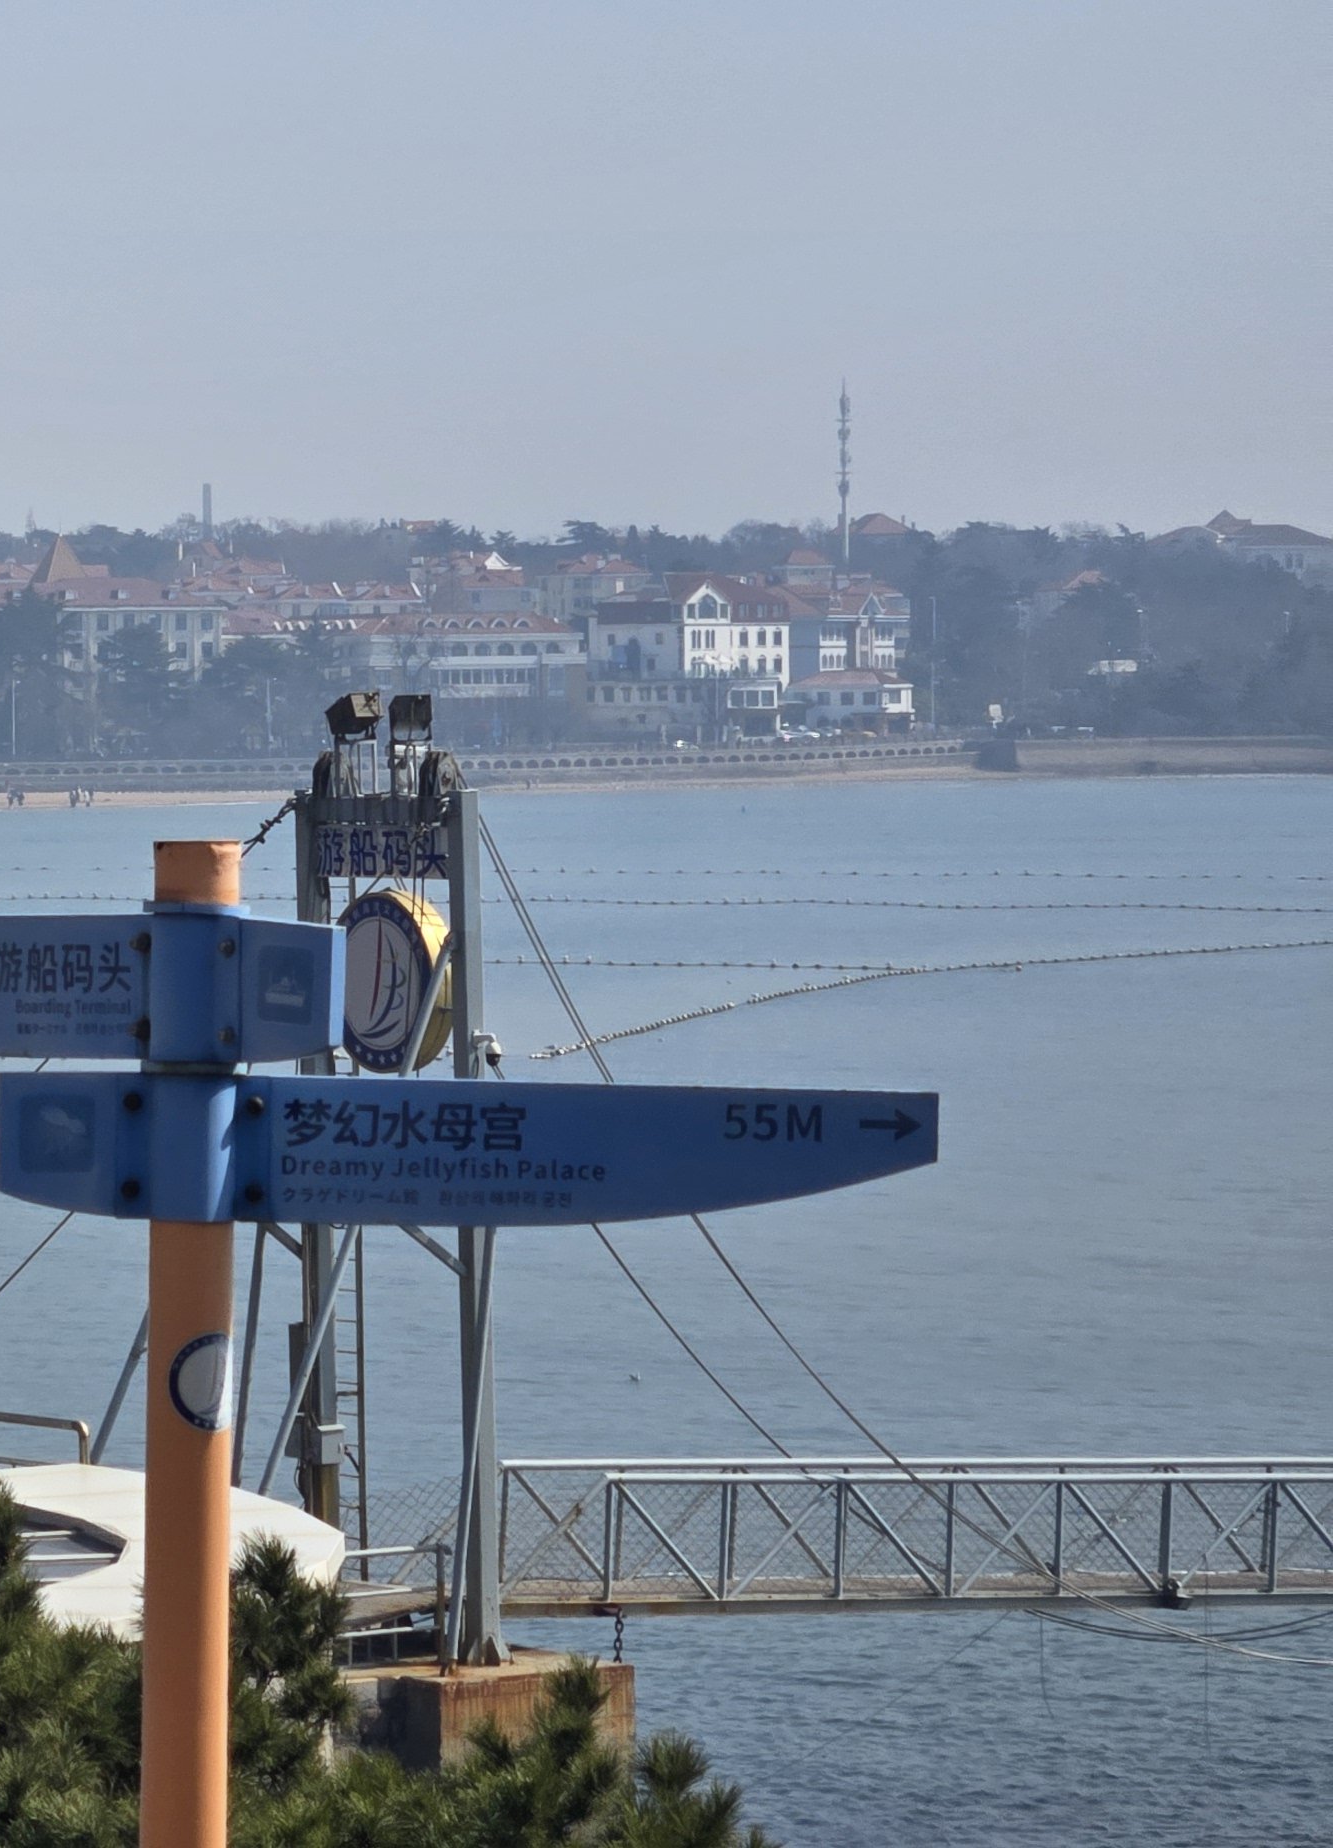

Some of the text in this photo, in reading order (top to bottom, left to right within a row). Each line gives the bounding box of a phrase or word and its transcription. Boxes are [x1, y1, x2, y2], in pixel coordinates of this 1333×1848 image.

[317, 828, 449, 878] 游船码头
[15, 998, 131, 1018] Boarding Terminal
[283, 1099, 527, 1152] 梦幻水母宫
[724, 1103, 823, 1142] 55M
[281, 1155, 607, 1183] Dreamy Jellyfish Palace
